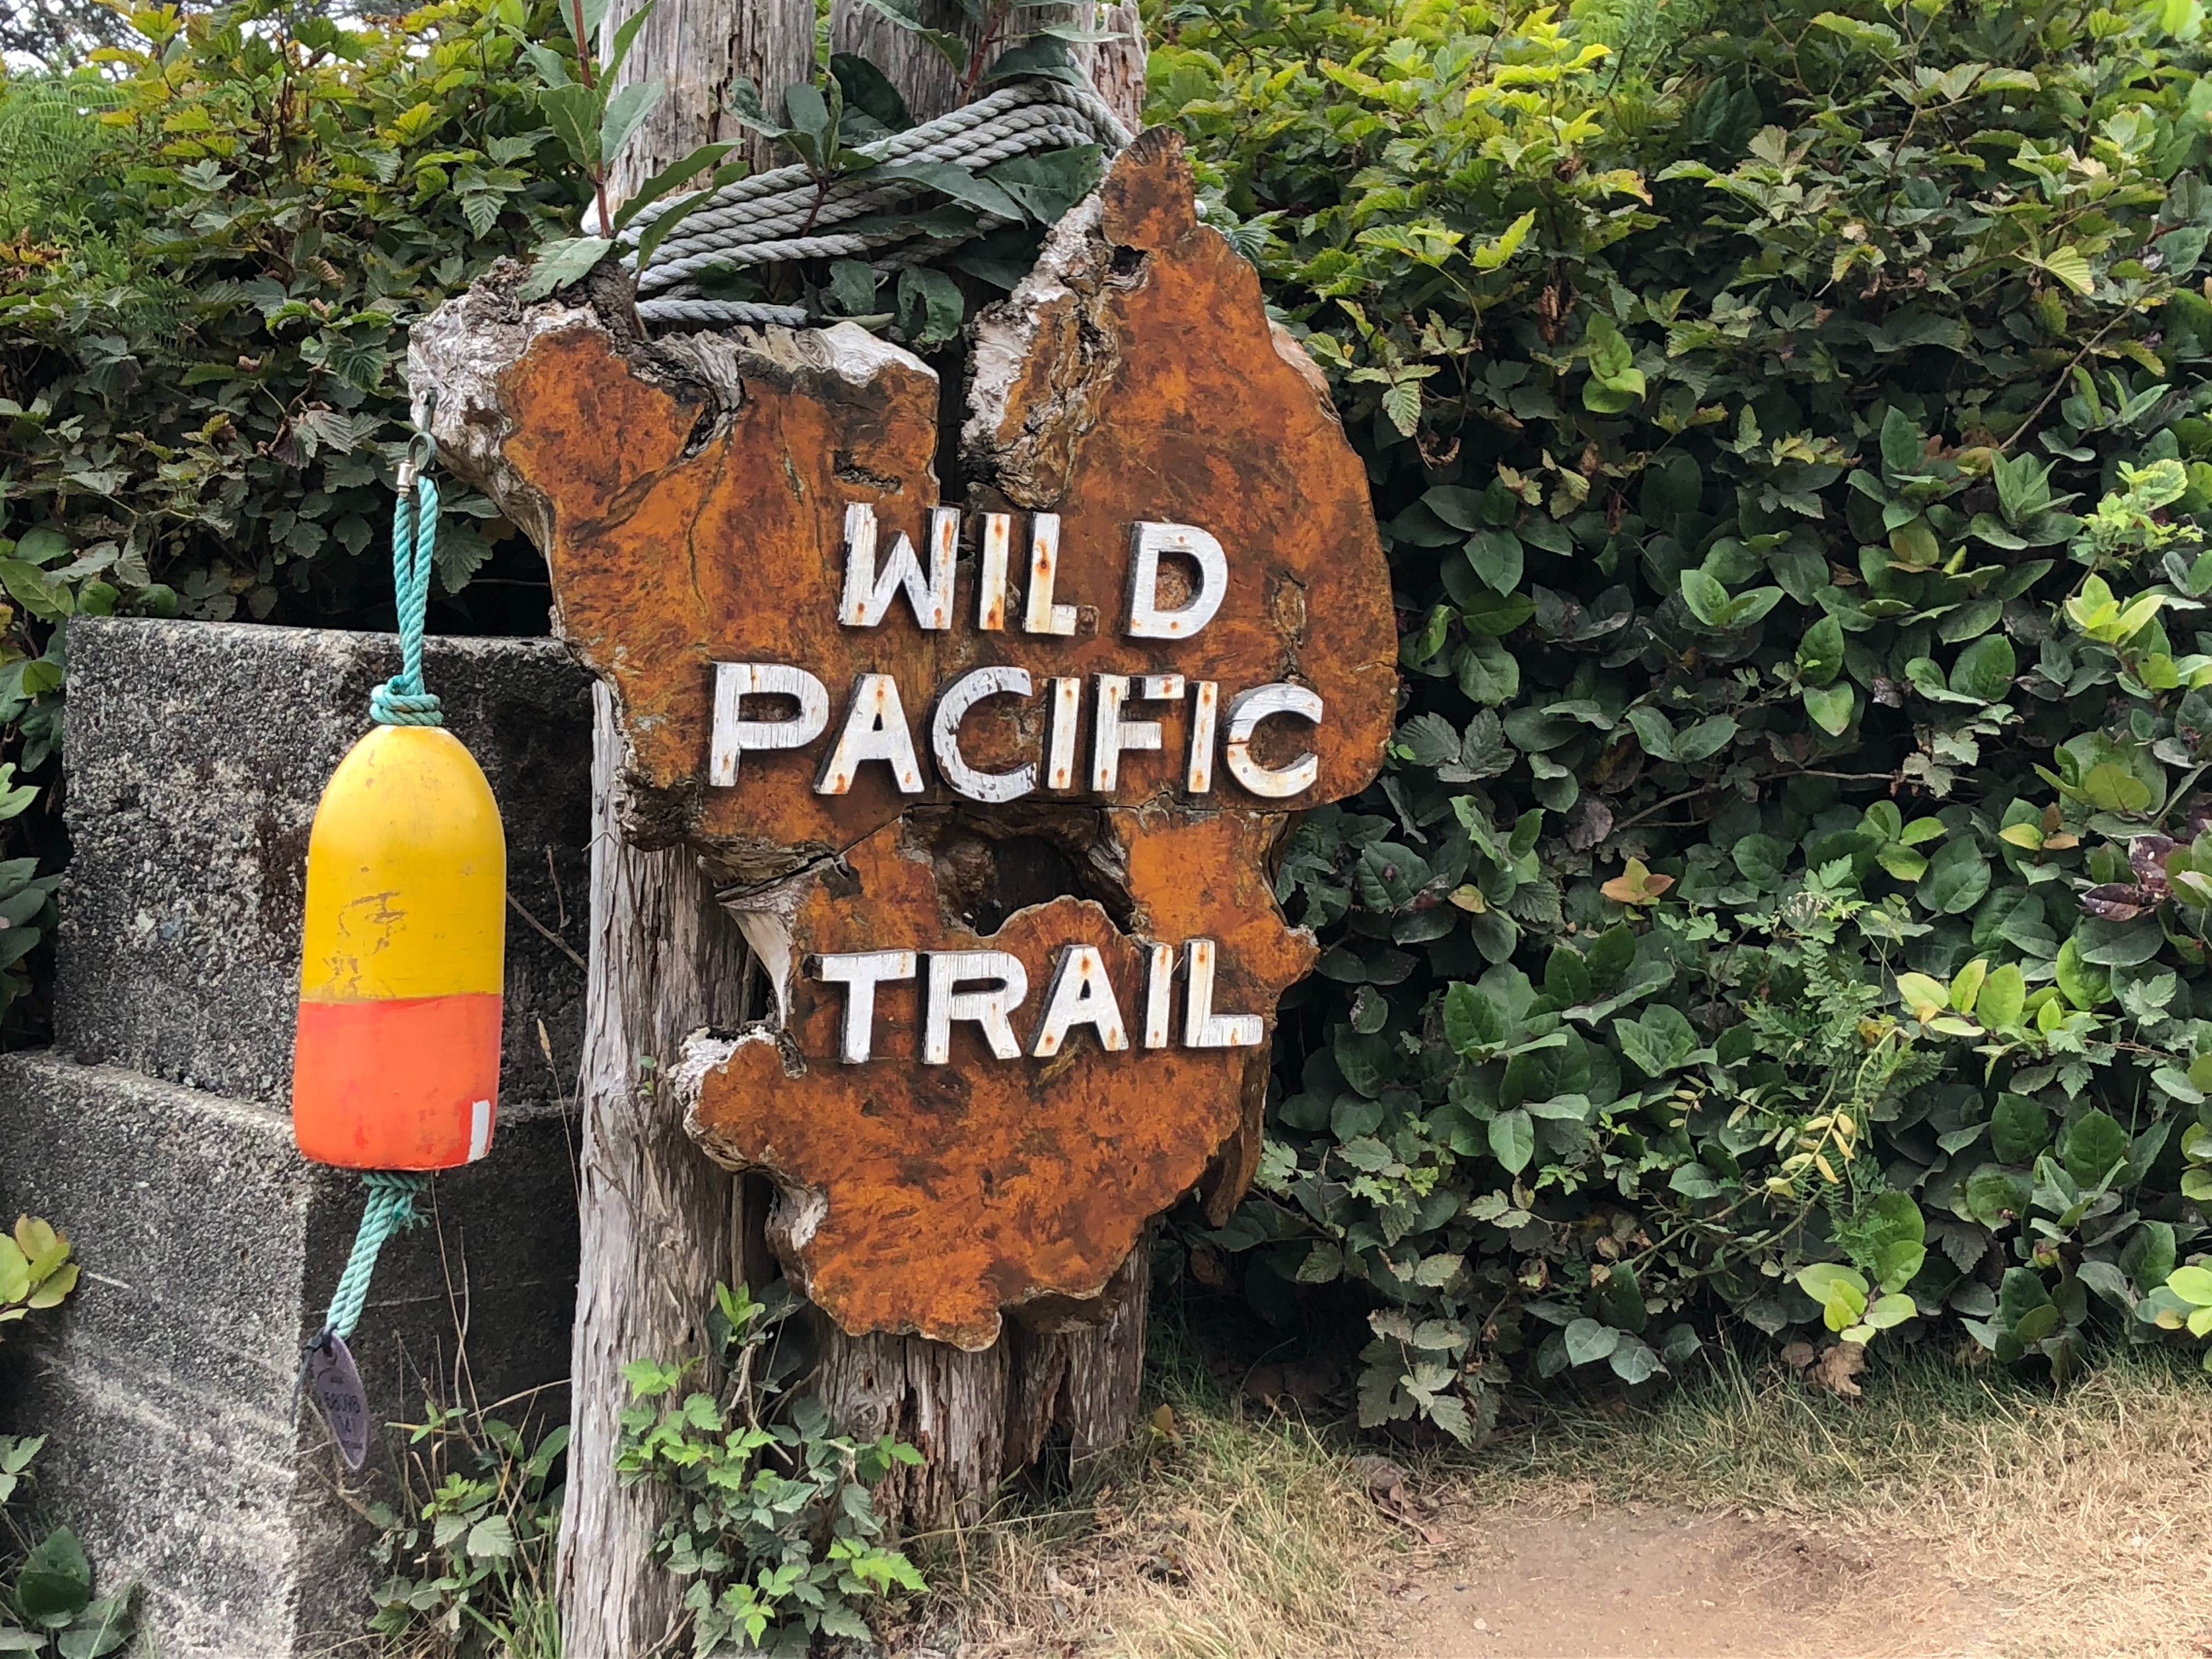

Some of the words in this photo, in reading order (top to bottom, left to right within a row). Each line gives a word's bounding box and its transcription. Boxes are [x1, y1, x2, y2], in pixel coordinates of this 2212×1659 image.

[838, 501, 1228, 640] WILD
[708, 661, 1324, 803] PACIFIC
[808, 939, 1264, 1064] TRAIL
